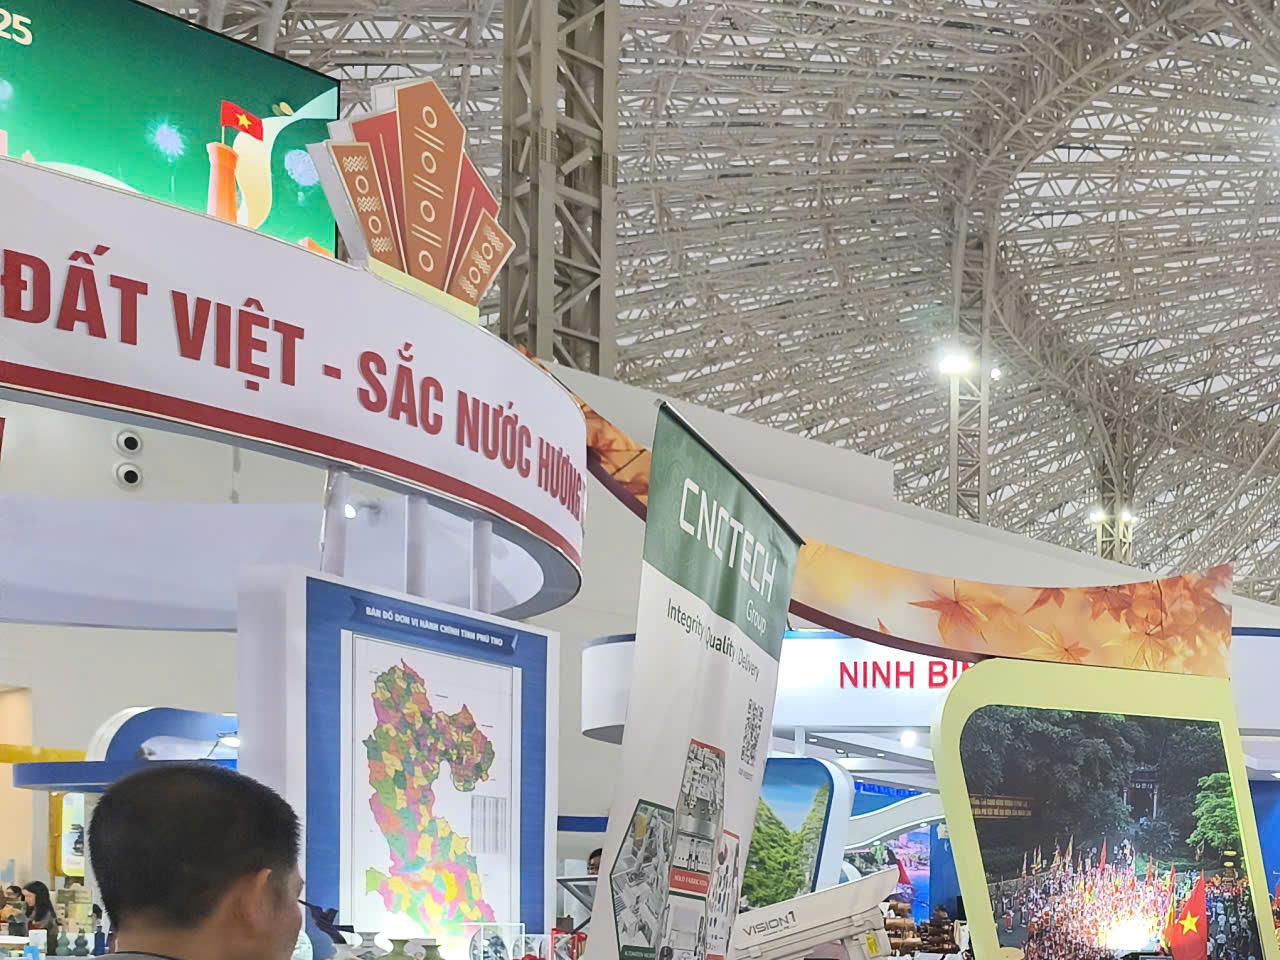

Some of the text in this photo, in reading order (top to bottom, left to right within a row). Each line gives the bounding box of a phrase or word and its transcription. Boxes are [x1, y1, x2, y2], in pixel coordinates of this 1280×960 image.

[1, 244, 148, 346] ĐẤT
[171, 297, 305, 391] VIỆT
[357, 343, 443, 435] SẮC
[455, 389, 532, 478] NƯỚC
[537, 437, 581, 521] HƯƠNG
[679, 477, 777, 602] CNCTECH
[668, 598, 704, 642] Integrity
[746, 599, 768, 637] Group
[840, 656, 973, 690] NINH BI
